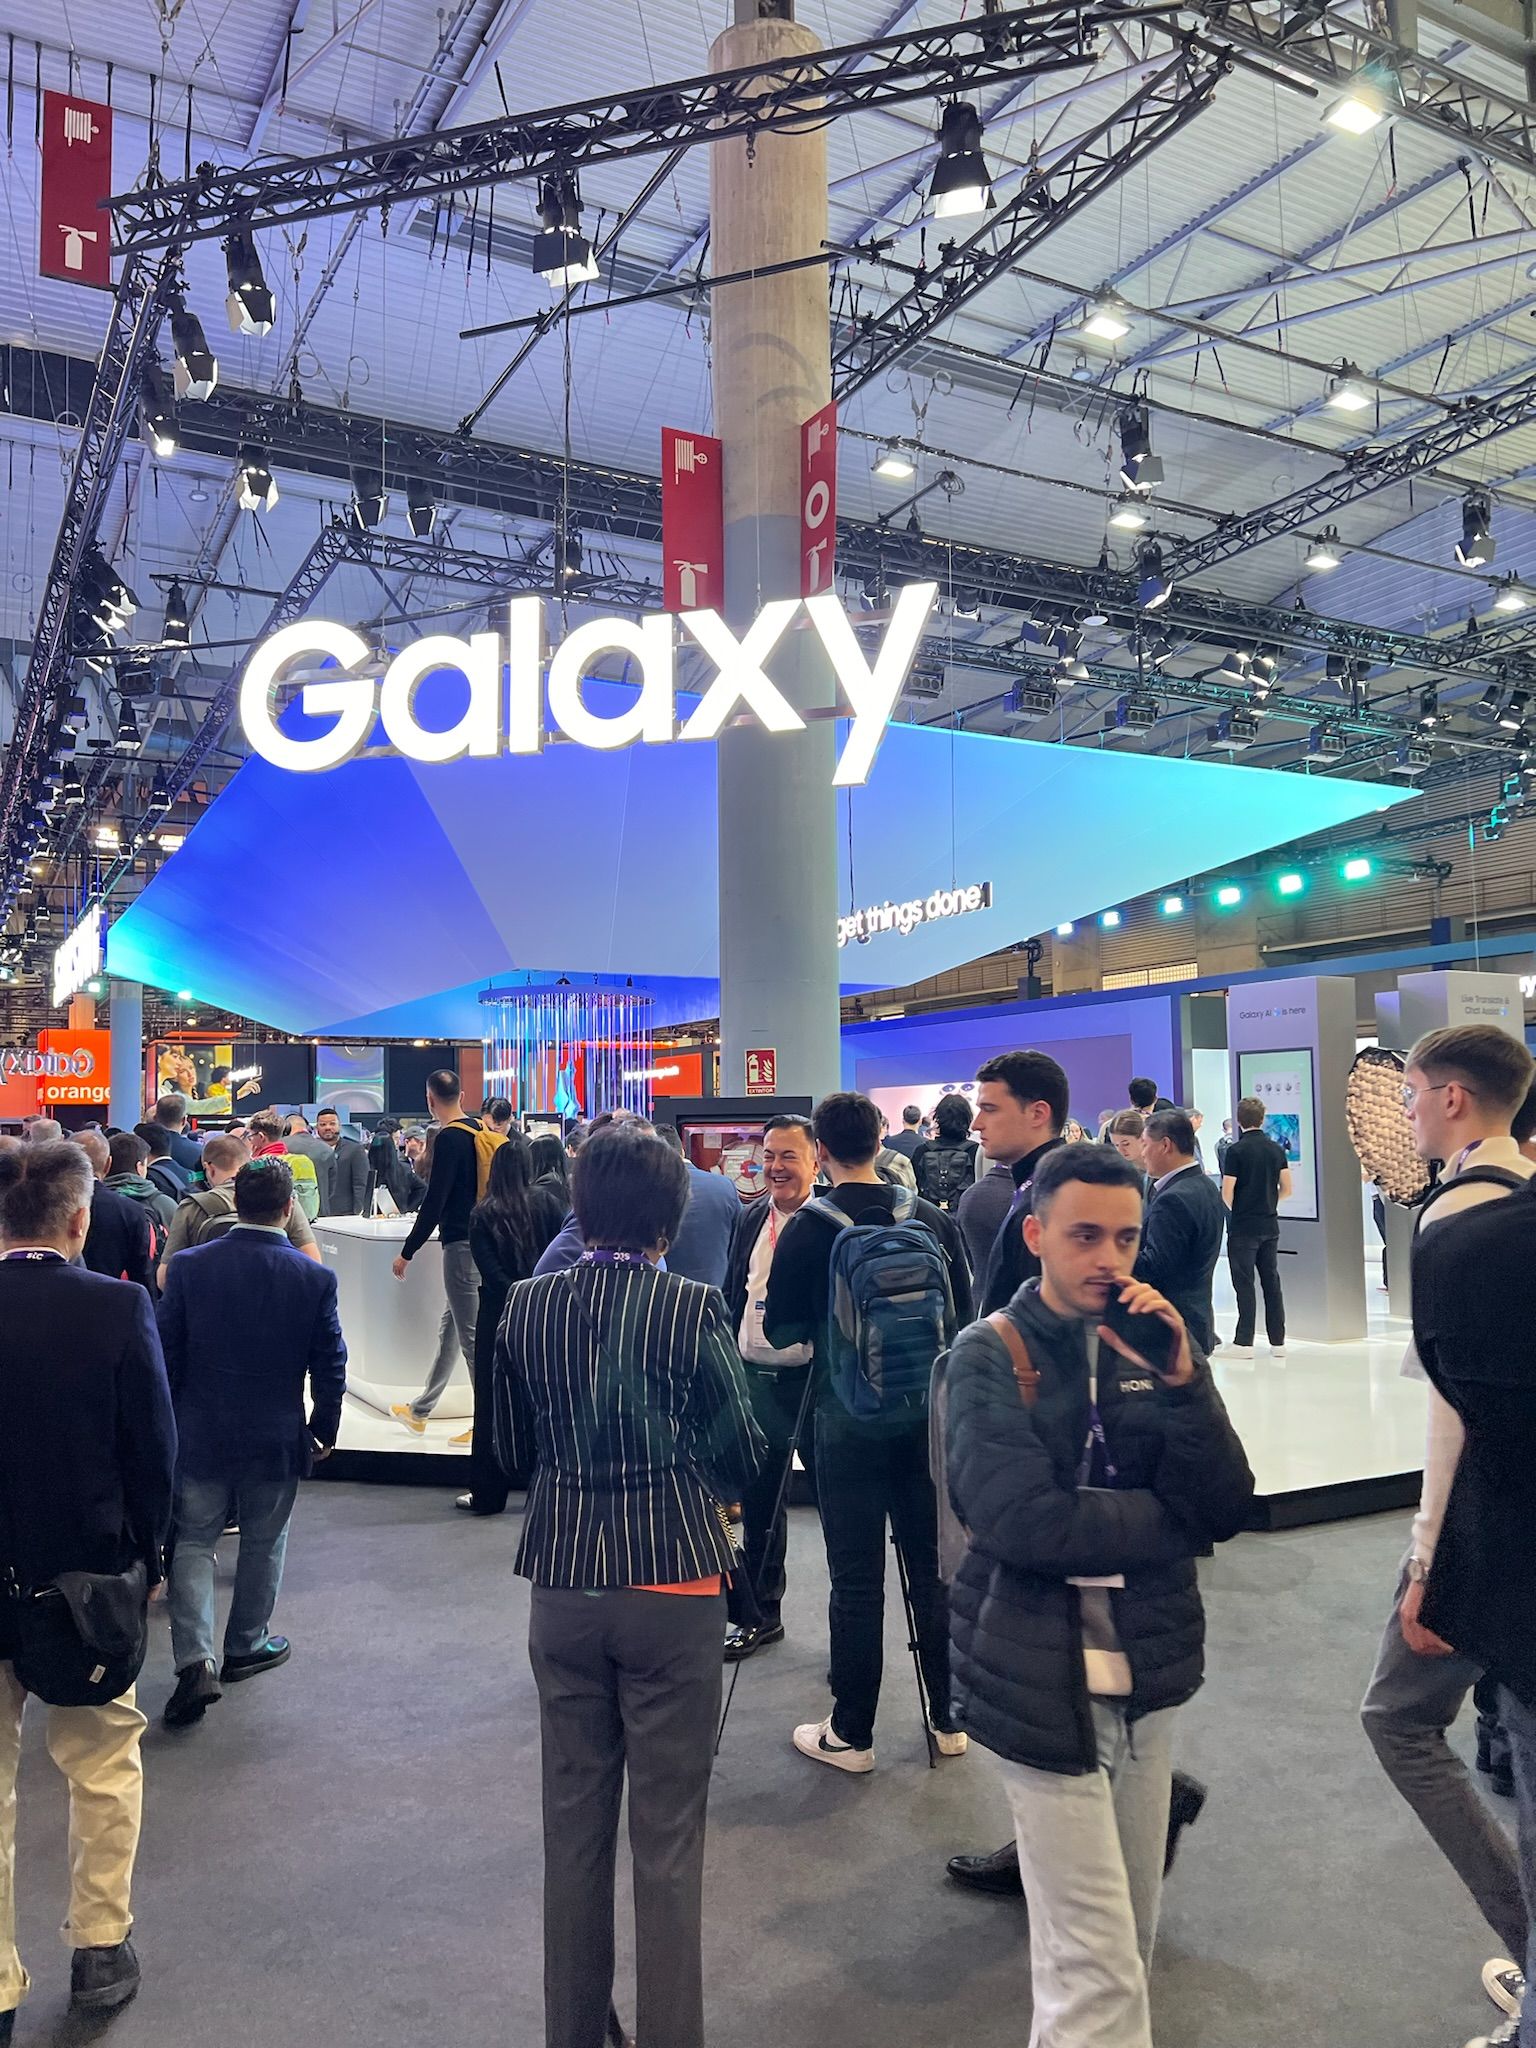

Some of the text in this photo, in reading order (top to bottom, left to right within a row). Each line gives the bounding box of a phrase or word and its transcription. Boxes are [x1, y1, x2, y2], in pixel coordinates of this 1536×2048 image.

[239, 582, 940, 788] Galaxy
[865, 900, 924, 935] things
[1239, 1011, 1263, 1020] Galaxy
[25, 1251, 44, 1261] stc
